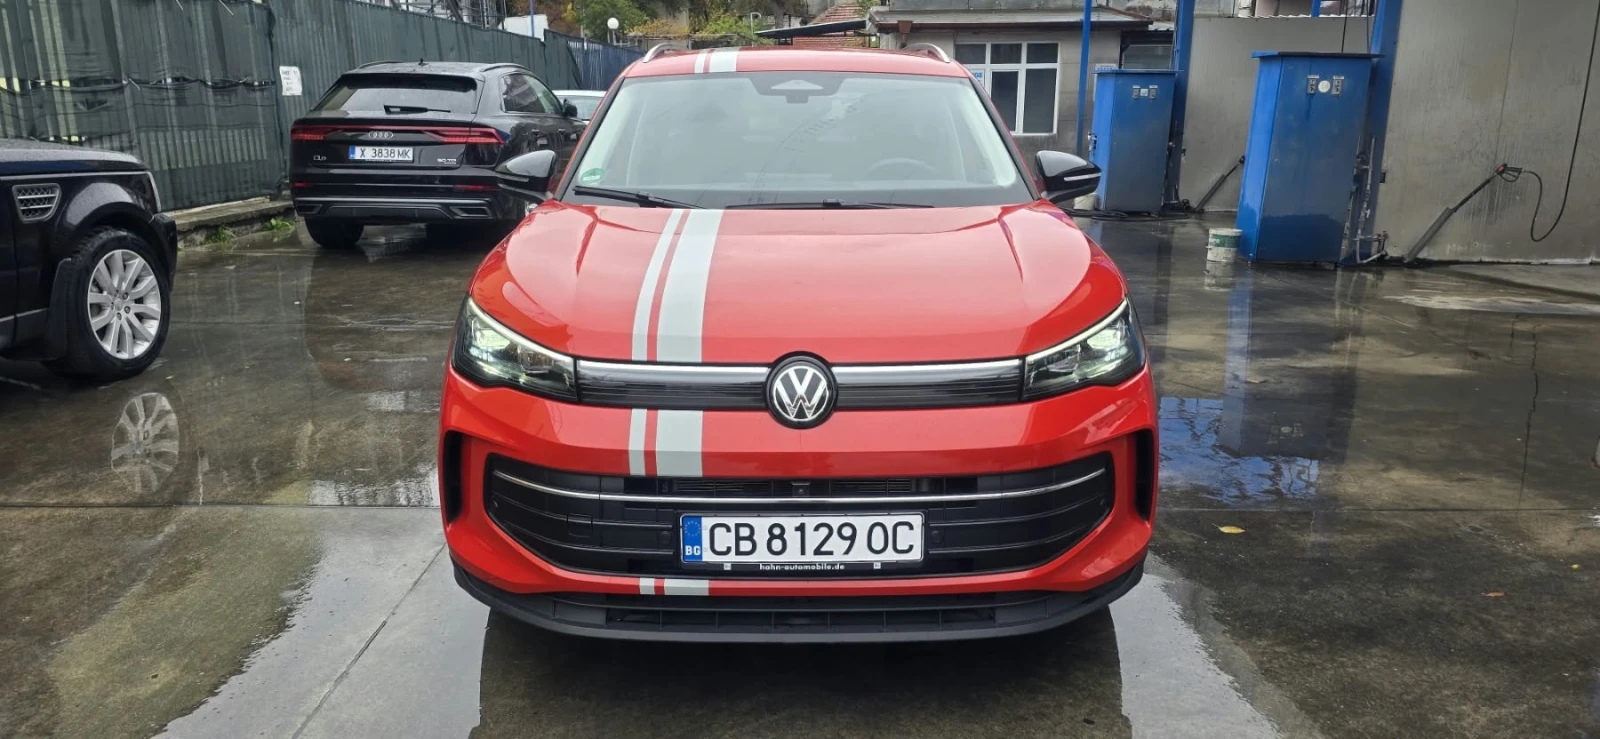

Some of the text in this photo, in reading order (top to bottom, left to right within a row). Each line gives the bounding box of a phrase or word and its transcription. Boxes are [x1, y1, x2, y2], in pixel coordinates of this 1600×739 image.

[360, 147, 366, 158] X
[371, 148, 396, 158] 3838
[397, 148, 411, 159] MK
[709, 521, 914, 556] CB 8129 OC
[685, 545, 701, 556] BG
[759, 563, 845, 571] hahn-automobile.de
